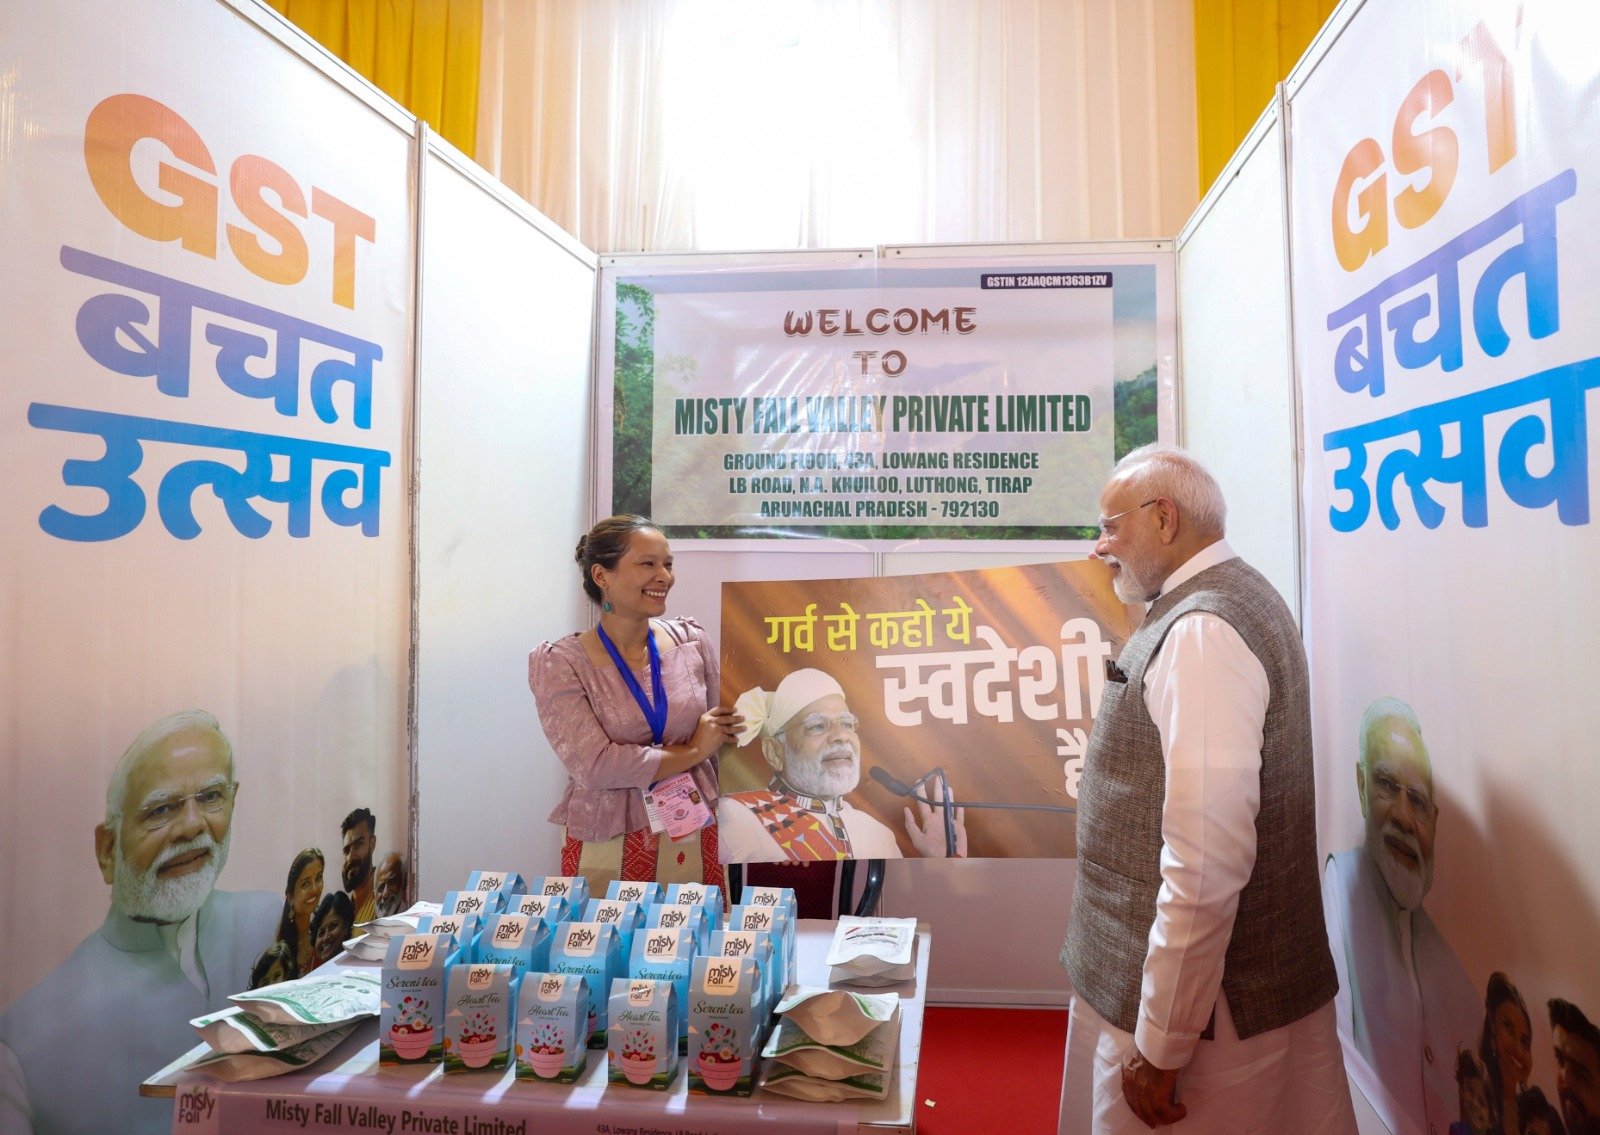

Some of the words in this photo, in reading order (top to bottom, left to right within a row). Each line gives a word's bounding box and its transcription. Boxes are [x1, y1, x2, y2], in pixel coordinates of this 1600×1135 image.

[1331, 4, 1524, 273] GST
[84, 93, 376, 312] GST
[987, 276, 1015, 287] GSTIN
[1326, 168, 1577, 398] बचत
[59, 244, 384, 430] बचत
[783, 306, 978, 338] WELCOME
[852, 350, 908, 378] TO
[675, 397, 747, 435] MISTY
[753, 396, 801, 434] FALL
[806, 395, 888, 433] VALLEY
[892, 394, 990, 433] PRIVATE
[996, 394, 1092, 432] LIMITED
[723, 453, 787, 470] GROUND
[790, 452, 841, 471] FLOOR,
[844, 452, 879, 471] 43A,
[882, 452, 949, 470] LOWANG
[953, 452, 1040, 470] RESIDENCE
[1322, 356, 1600, 534] उत्सव
[27, 402, 392, 543] उत्सव
[729, 477, 747, 494] LB
[751, 477, 796, 495] ROAD,
[800, 476, 828, 494] N.A.
[831, 476, 903, 495] KHUILOO,
[906, 476, 983, 496] LUTHONG,
[985, 476, 1034, 494] TIRAP
[761, 501, 852, 518] ARUNACHAL
[856, 500, 927, 518] PRADESH
[941, 500, 1000, 518] 792130
[764, 603, 818, 653] गर्व
[824, 602, 860, 652] से
[866, 597, 937, 649] कहो
[942, 595, 974, 646] ये
[875, 617, 1111, 728] स्वदेशी
[421, 976, 438, 987] tea
[729, 1003, 745, 1015] tea
[178, 1108, 200, 1124] Fall
[180, 1085, 216, 1119] misty
[266, 1099, 310, 1128] Misty
[315, 1103, 343, 1126] Fall
[348, 1106, 397, 1135] Valley
[402, 1110, 459, 1135] Private
[464, 1115, 526, 1135] Limited
